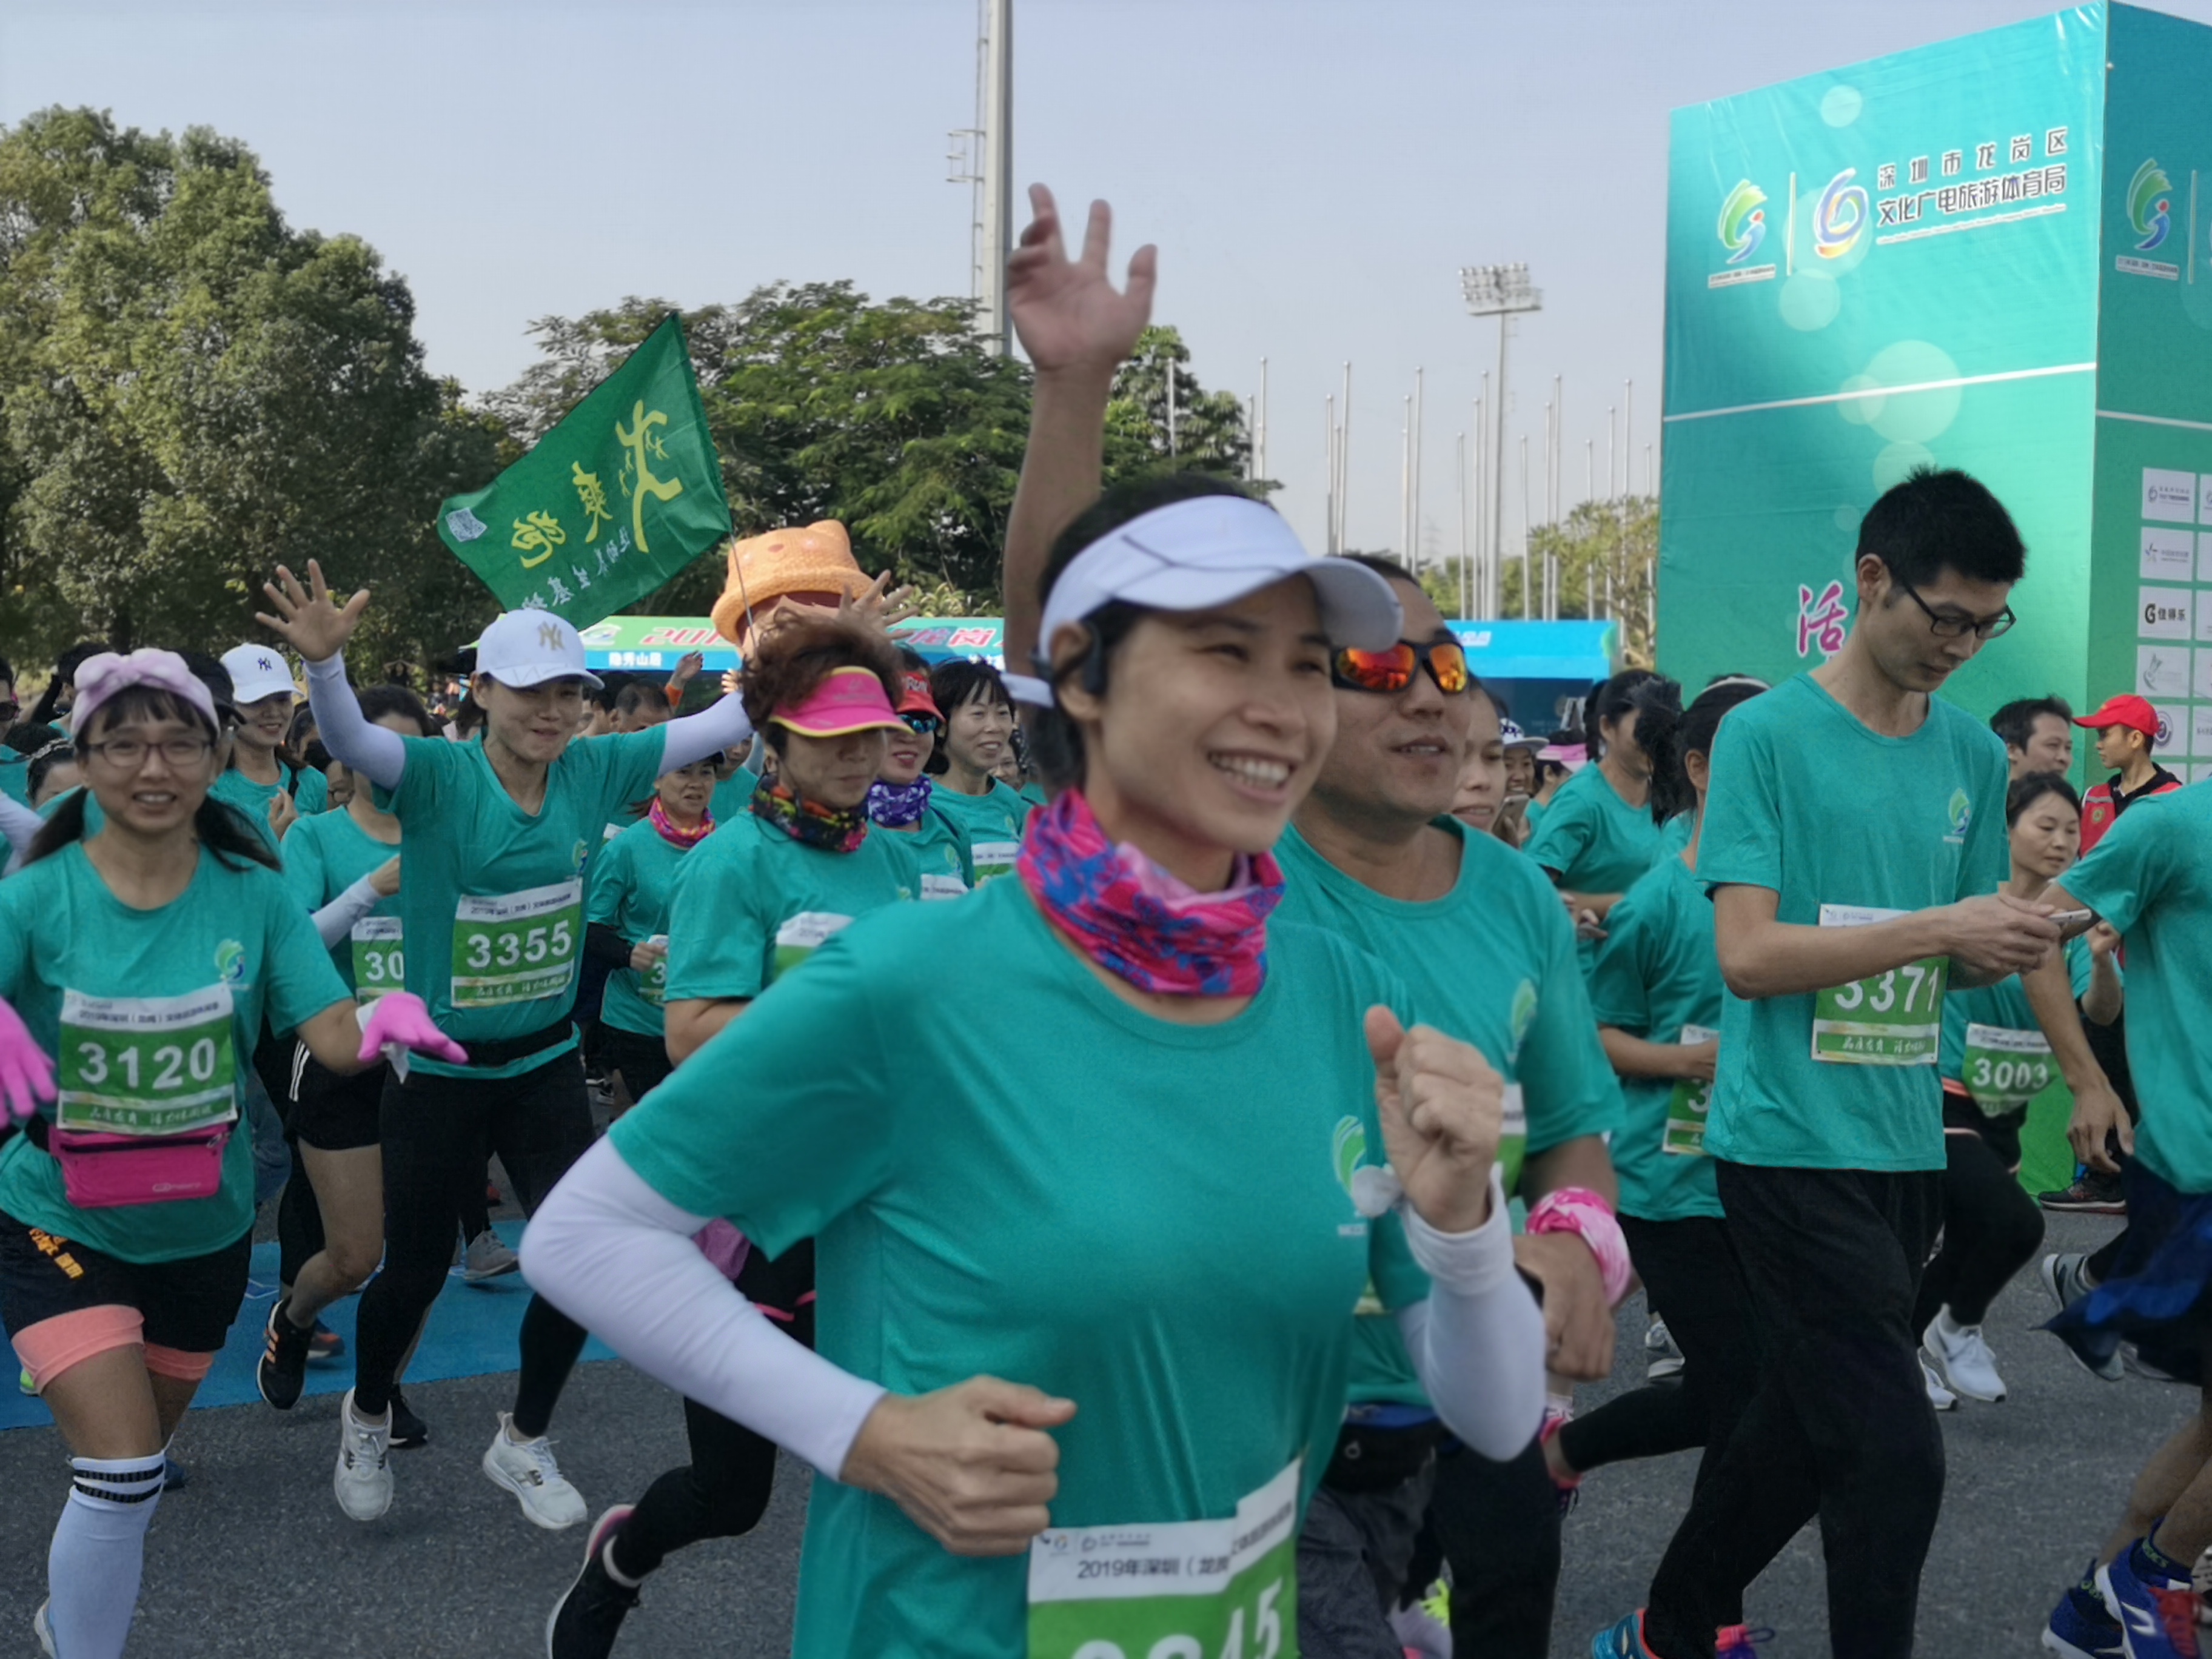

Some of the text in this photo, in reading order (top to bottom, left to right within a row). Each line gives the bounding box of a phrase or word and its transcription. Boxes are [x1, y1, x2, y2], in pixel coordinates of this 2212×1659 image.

[1879, 126, 2068, 190] 深圳市龙岗区
[1877, 163, 2066, 227] 文化广电旅游体育局
[537, 621, 565, 650] NY
[639, 627, 736, 646] 201
[1797, 579, 1848, 657] 活
[467, 920, 572, 968] 3355
[1834, 965, 1939, 1012] 3371
[78, 1037, 215, 1090] 3120
